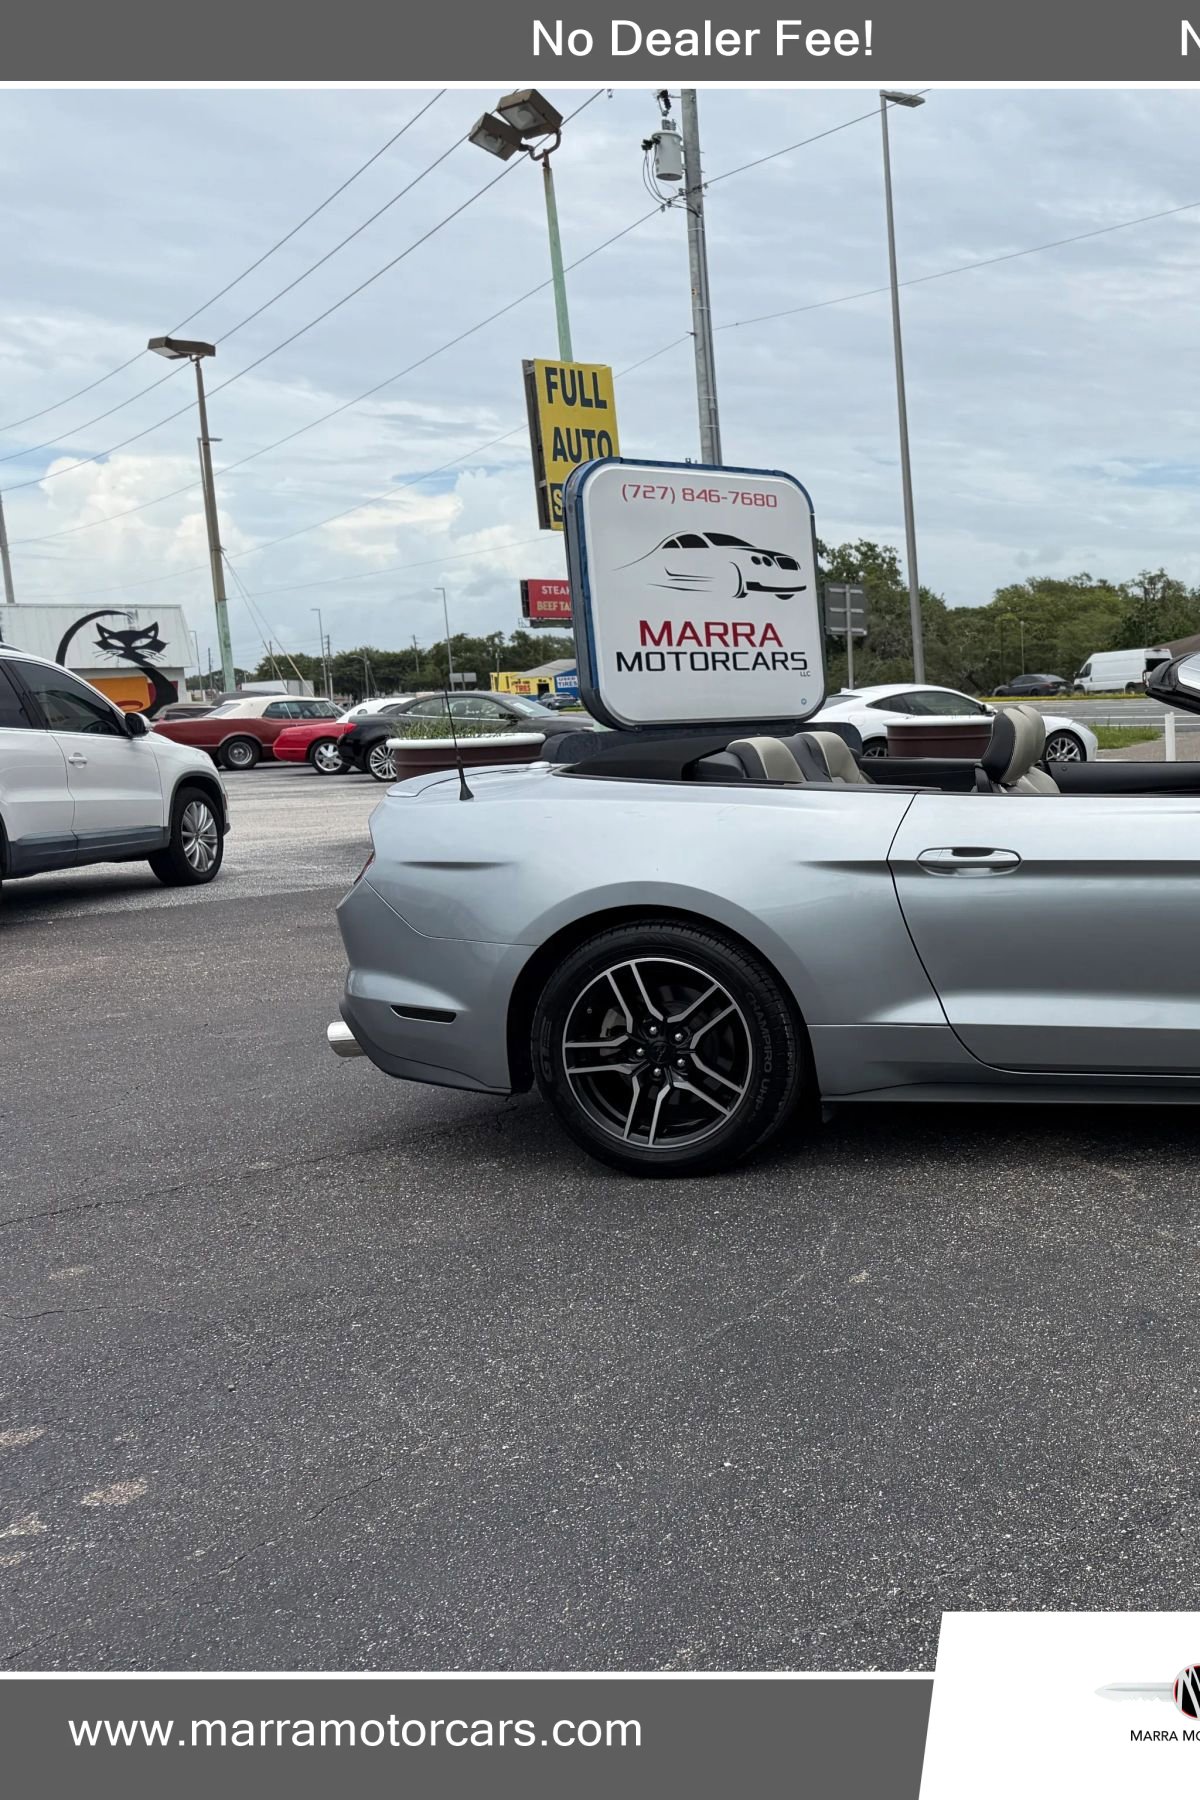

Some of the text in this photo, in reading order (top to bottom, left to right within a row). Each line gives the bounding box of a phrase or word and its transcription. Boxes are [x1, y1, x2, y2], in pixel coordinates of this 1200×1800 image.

[545, 366, 608, 409] FULL
[552, 426, 614, 463] AUTO
[621, 484, 778, 508] (727) 846-7680
[536, 601, 572, 611] BEEF TA
[638, 619, 784, 648] MARRA
[615, 651, 808, 672] MOTORCARS
